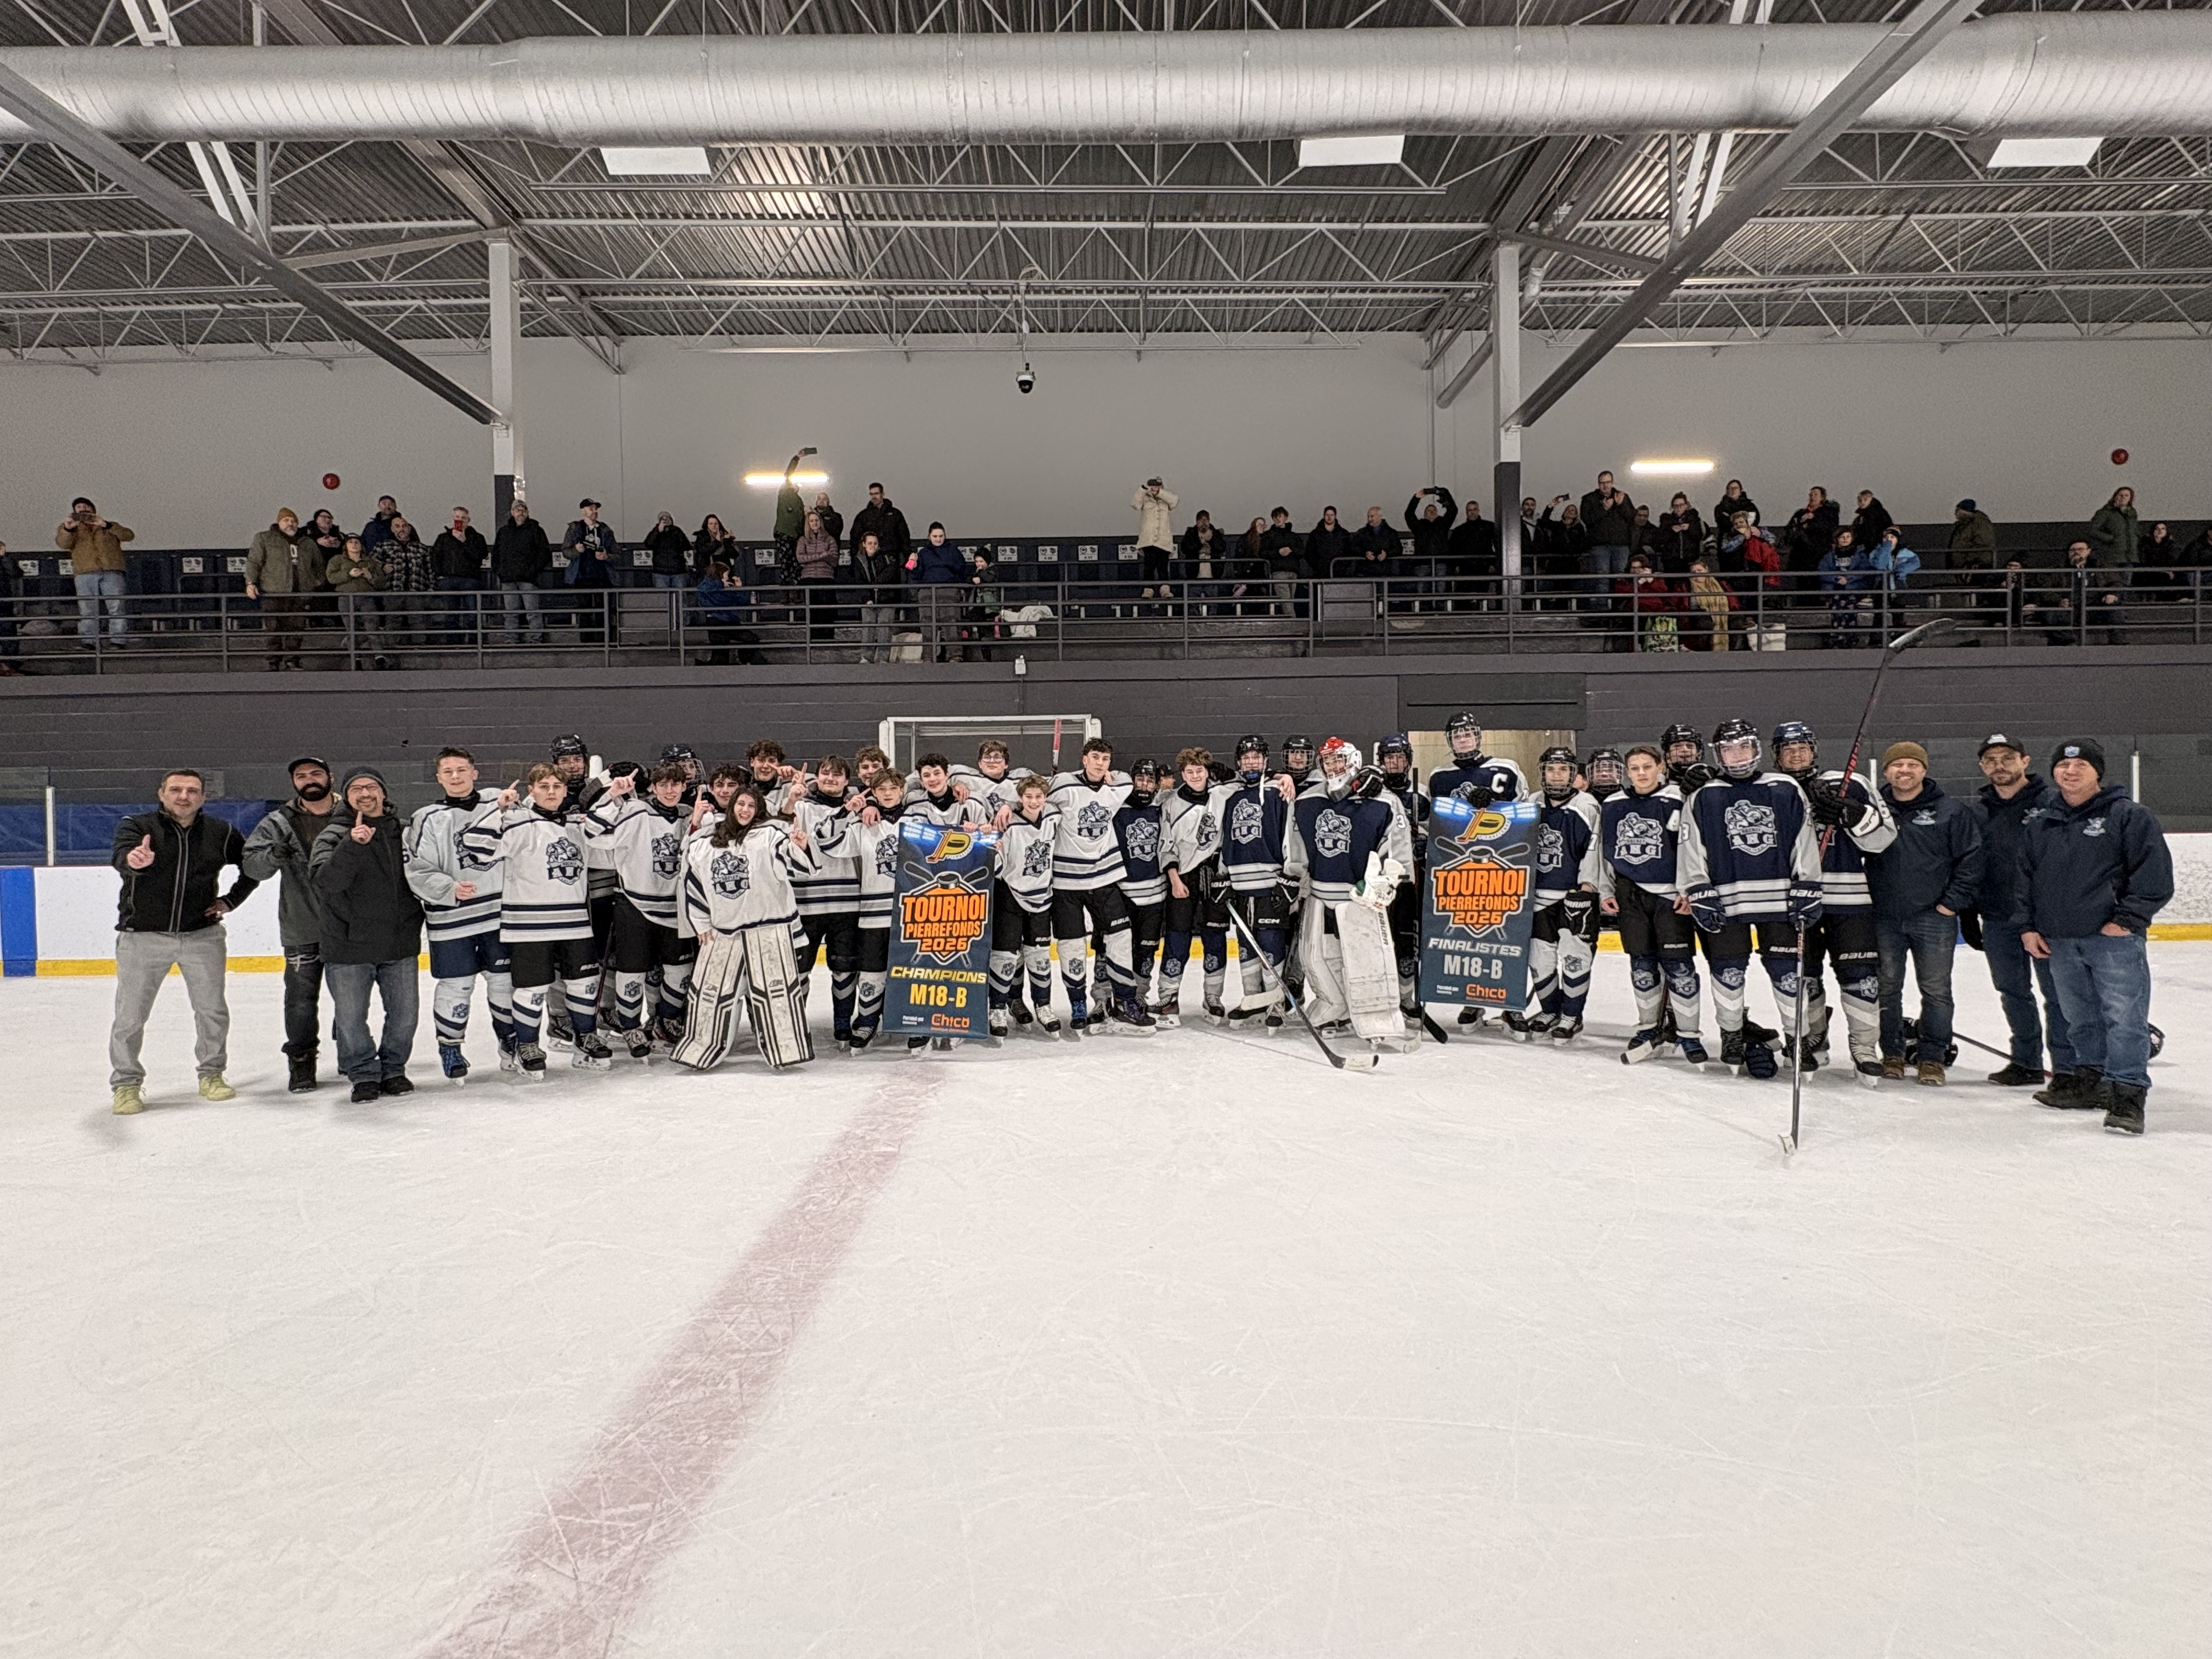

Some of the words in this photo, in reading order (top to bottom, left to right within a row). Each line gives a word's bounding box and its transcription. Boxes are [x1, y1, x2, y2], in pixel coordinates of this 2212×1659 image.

[1491, 773, 1508, 794] C
[960, 808, 969, 825] A
[1436, 870, 1525, 895] TOURNOI
[904, 894, 985, 922] TOURNOI
[1438, 895, 1519, 911] PIERREFONDS
[1454, 911, 1502, 924] 2026
[906, 921, 981, 938] PIERREFONDS
[921, 938, 968, 951] 2026
[1428, 938, 1523, 957] FINALISTES
[891, 966, 988, 984] CHAMPIONS
[1443, 954, 1503, 980] M18-B
[910, 984, 968, 1008] M18-B
[1466, 984, 1506, 999] Chico
[932, 1013, 970, 1028] Chico
